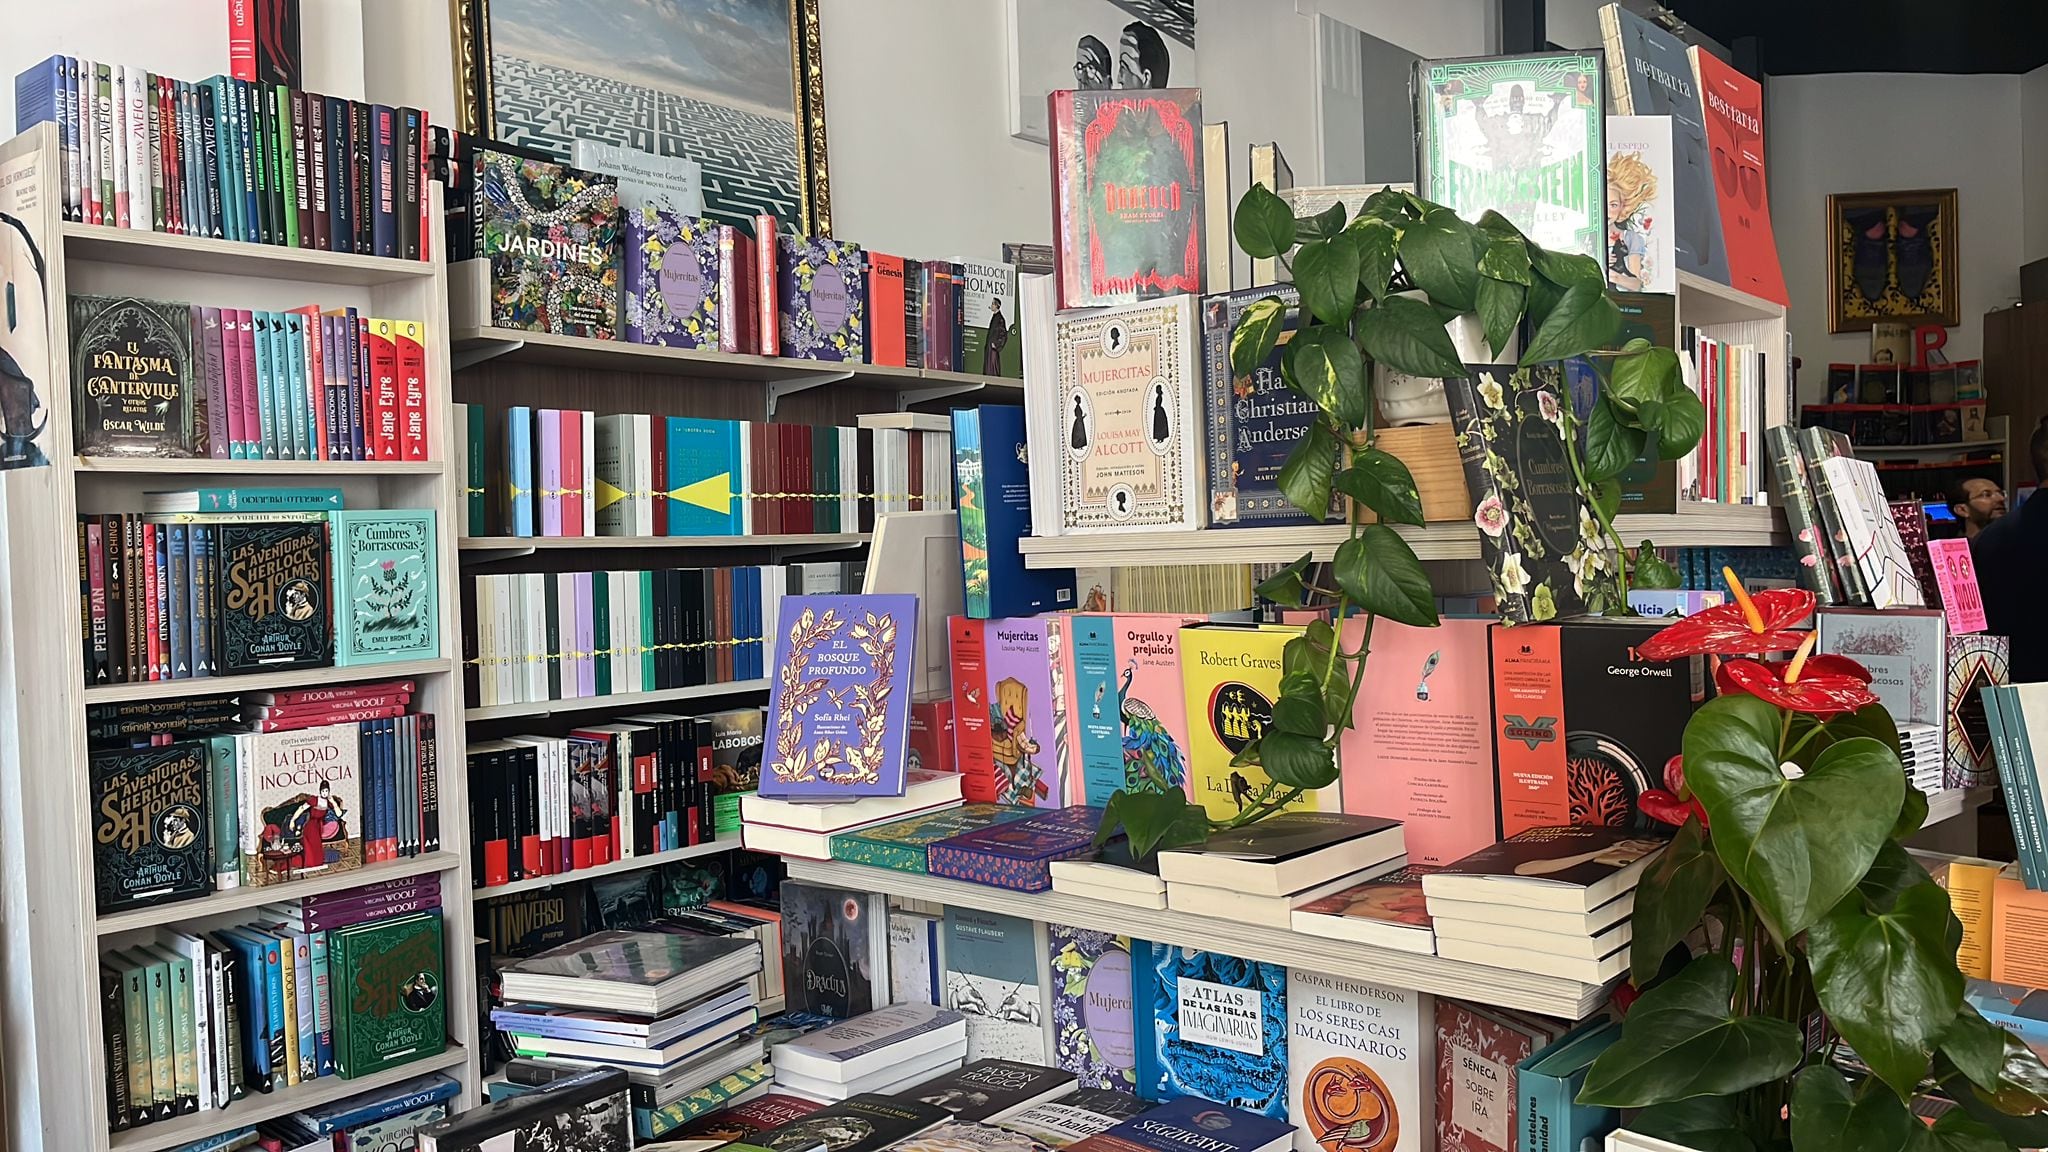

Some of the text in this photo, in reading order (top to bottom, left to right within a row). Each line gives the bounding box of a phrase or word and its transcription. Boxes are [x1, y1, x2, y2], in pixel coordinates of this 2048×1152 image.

[99, 103, 111, 143] ZWEIG
[133, 99, 144, 139] ZWEIG
[204, 118, 216, 156] ZWEIG
[244, 147, 253, 192] NIETZSCHE
[598, 160, 620, 170] Johann
[622, 164, 651, 177] Wolfgang
[665, 173, 686, 183] Goethe
[499, 233, 603, 266] JARDINES
[663, 269, 699, 283] Mujercitas
[877, 265, 903, 279] Génesis
[963, 263, 1006, 280] SHERLOCK
[812, 290, 845, 301] Mujercitas
[964, 278, 1006, 296] HOLMES
[127, 342, 139, 355] EL
[94, 351, 177, 376] FANTASMA
[1083, 365, 1151, 385] MUJERCITAS
[88, 376, 179, 400] CANTERVILLE
[328, 389, 336, 434] MEDITACIONES
[340, 389, 348, 434] MEDITACIONES
[379, 376, 396, 440] Jane Eyre
[406, 377, 423, 440] Jane Eyre
[1235, 394, 1319, 422] Christian
[103, 419, 165, 433] OSCAR WILDE
[1097, 429, 1140, 440] LOUISA MAY
[1237, 420, 1309, 452] Anderse
[1095, 442, 1143, 456] ALCOTT
[1114, 469, 1145, 477] MATTESON
[109, 521, 118, 554] CHING
[366, 527, 410, 541] Cumbres
[232, 544, 255, 561] LAS
[250, 534, 314, 569] AVENTURAS
[358, 540, 419, 551] Borrascosas
[227, 550, 316, 610] SHERLOCK
[158, 565, 168, 640] CUENTOS ANDERSEN
[249, 561, 320, 623] HOLMES
[92, 588, 106, 651] PETER PAN
[262, 634, 290, 643] ARTHUR
[832, 640, 848, 649] EL
[997, 631, 1039, 643] Mujercitas
[1127, 631, 1173, 644] Orgullo y
[250, 642, 302, 654] CONAN DOYLE
[817, 653, 860, 663] BOSQUE
[1132, 645, 1174, 656] prejuicio
[808, 666, 867, 676] PROFUNDO
[1200, 651, 1282, 670] Robert Graves
[1607, 665, 1672, 679] George Orwell
[814, 713, 831, 721] Sofía
[280, 734, 330, 746] EDITH WHARTON
[712, 735, 762, 750] LABOBOS
[272, 745, 339, 767] LA EDAD
[103, 773, 128, 793] LAS
[122, 755, 196, 798] AVENTURAS
[260, 765, 353, 791] INOCENCIA
[1206, 776, 1223, 792] La
[421, 773, 429, 805] LAZARILLO
[97, 772, 199, 845] SHERLOCK
[121, 784, 201, 854] HOLMES
[2008, 787, 2026, 850] CANCIONERO POPULAR
[2023, 789, 2042, 852] CANCIONERO POPULAR
[1424, 852, 1439, 862] ALMA
[123, 871, 182, 889] CONAN DOYLE
[135, 865, 169, 879] ARTHUR
[385, 889, 416, 901] WOOLF
[387, 901, 418, 913] WOOLF
[490, 898, 564, 955] UNIVERSO
[955, 924, 1004, 937] GUSTAVE FLAUBERT
[1192, 986, 1244, 1008] ATLAS
[1294, 972, 1406, 1004] CASPAR HENDERSON
[1089, 991, 1132, 1010] Mujerci
[1182, 999, 1257, 1020] DE LAS ISLAS
[1315, 995, 1382, 1018] EL LIBRO DE
[1182, 1010, 1258, 1041] IMAGINARIAS
[1300, 1007, 1400, 1040] LOS SERES CASI
[375, 1033, 422, 1052] CONAN DOYLE
[1294, 1022, 1408, 1061] IMAGINARIOS
[112, 1033, 121, 1072] SECRETO
[1462, 1057, 1498, 1083] SÉNECA
[1465, 1078, 1494, 1101] SOBRE
[382, 1092, 436, 1113] VIRGINIA WOOLF
[1471, 1100, 1489, 1119] IRA
[1018, 1110, 1060, 1123] Tierra
[1039, 1104, 1071, 1115] ROBERT
[1082, 1115, 1114, 1127] KAPLA
[1528, 1097, 1537, 1145] estelares
